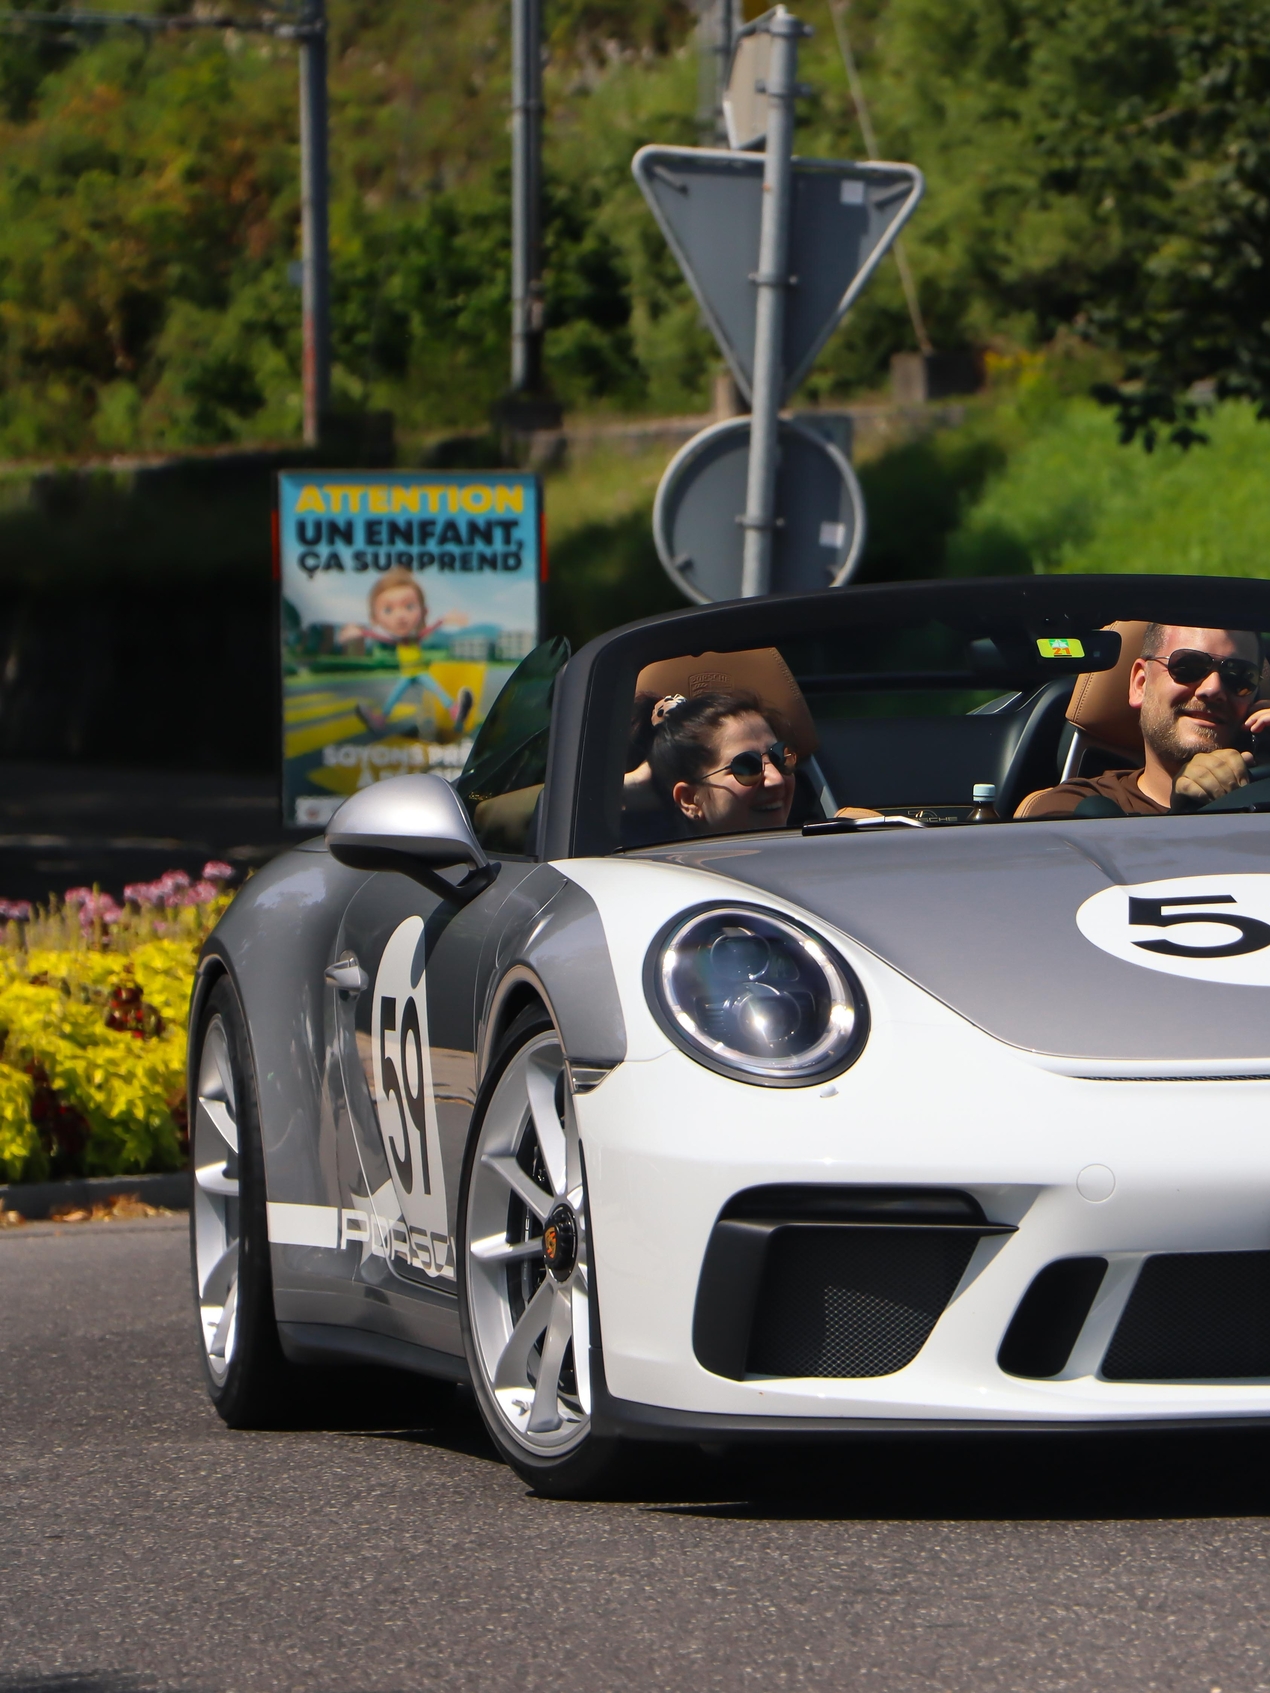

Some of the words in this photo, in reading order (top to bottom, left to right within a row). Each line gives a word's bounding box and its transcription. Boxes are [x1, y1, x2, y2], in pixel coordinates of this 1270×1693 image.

[295, 484, 524, 513] ATTENTION
[296, 518, 353, 547] UN
[364, 519, 523, 554] ENFANT,
[297, 551, 345, 578] ÇA
[352, 551, 522, 573] SURPREND
[1052, 647, 1071, 655] 21
[380, 996, 432, 1196] 59
[340, 1208, 458, 1281] PORSC
